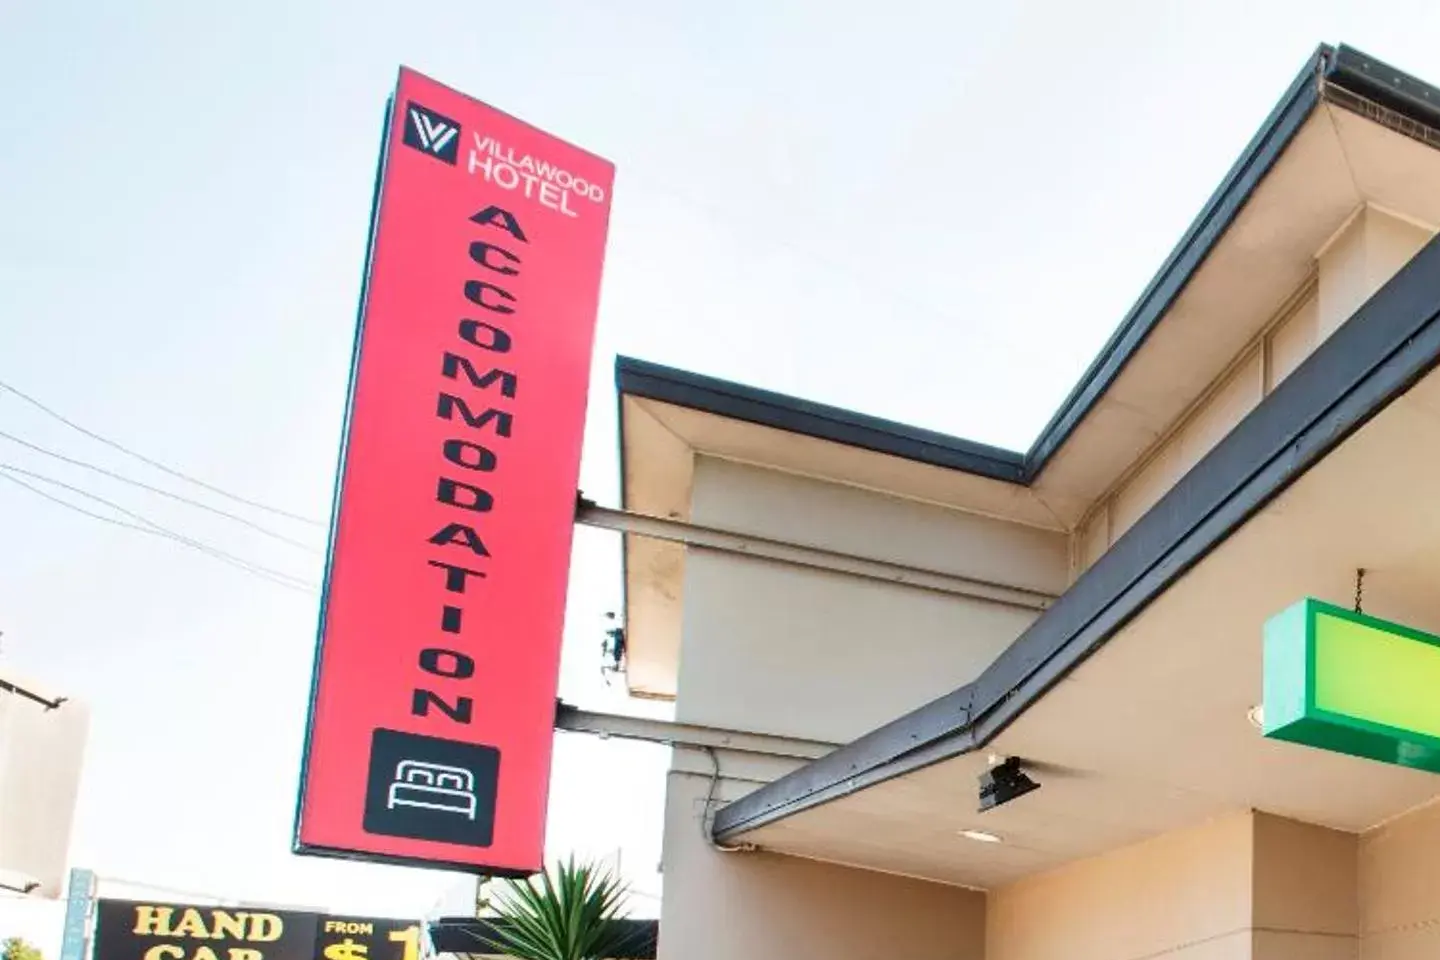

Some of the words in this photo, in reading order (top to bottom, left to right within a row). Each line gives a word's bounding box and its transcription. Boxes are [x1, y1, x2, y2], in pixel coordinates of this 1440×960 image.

[467, 154, 579, 218] HOTEL
[471, 131, 605, 202] VILLAWOOD
[411, 205, 529, 725] ACCOMMODATION
[132, 905, 284, 942] HAND
[324, 921, 374, 936] FROM
